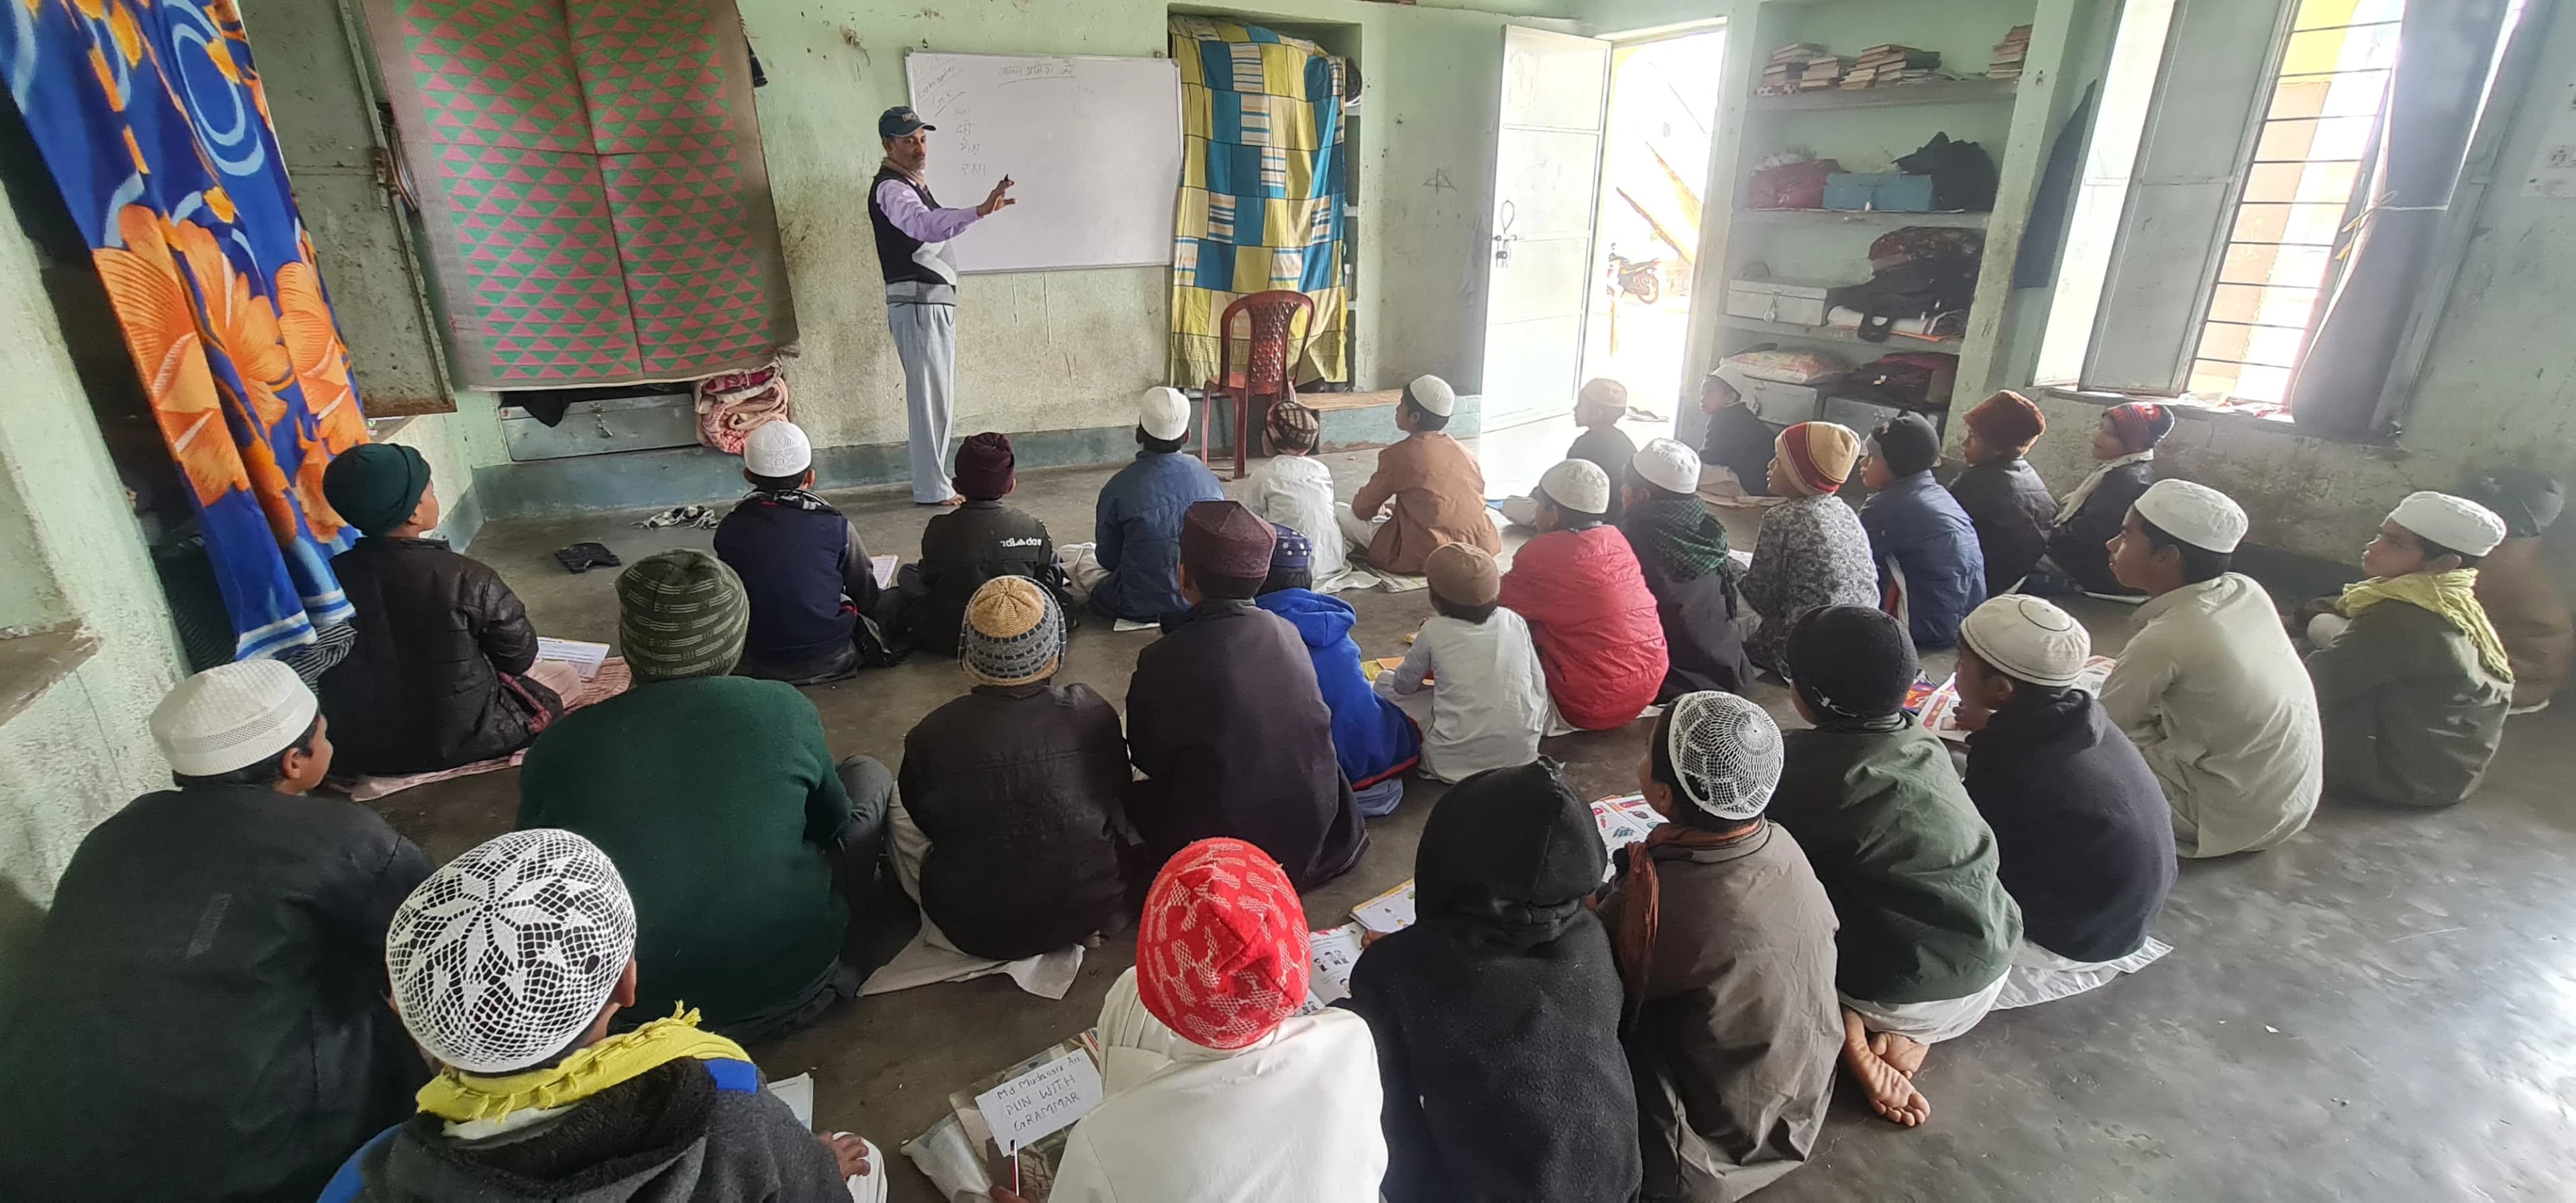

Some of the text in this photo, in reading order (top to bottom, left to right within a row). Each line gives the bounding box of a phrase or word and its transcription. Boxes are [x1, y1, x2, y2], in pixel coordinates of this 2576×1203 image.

[997, 1087, 1016, 1100] Md
[1039, 1075, 1076, 1100] WITH
[1014, 1092, 1079, 1132] GRAMMAR
